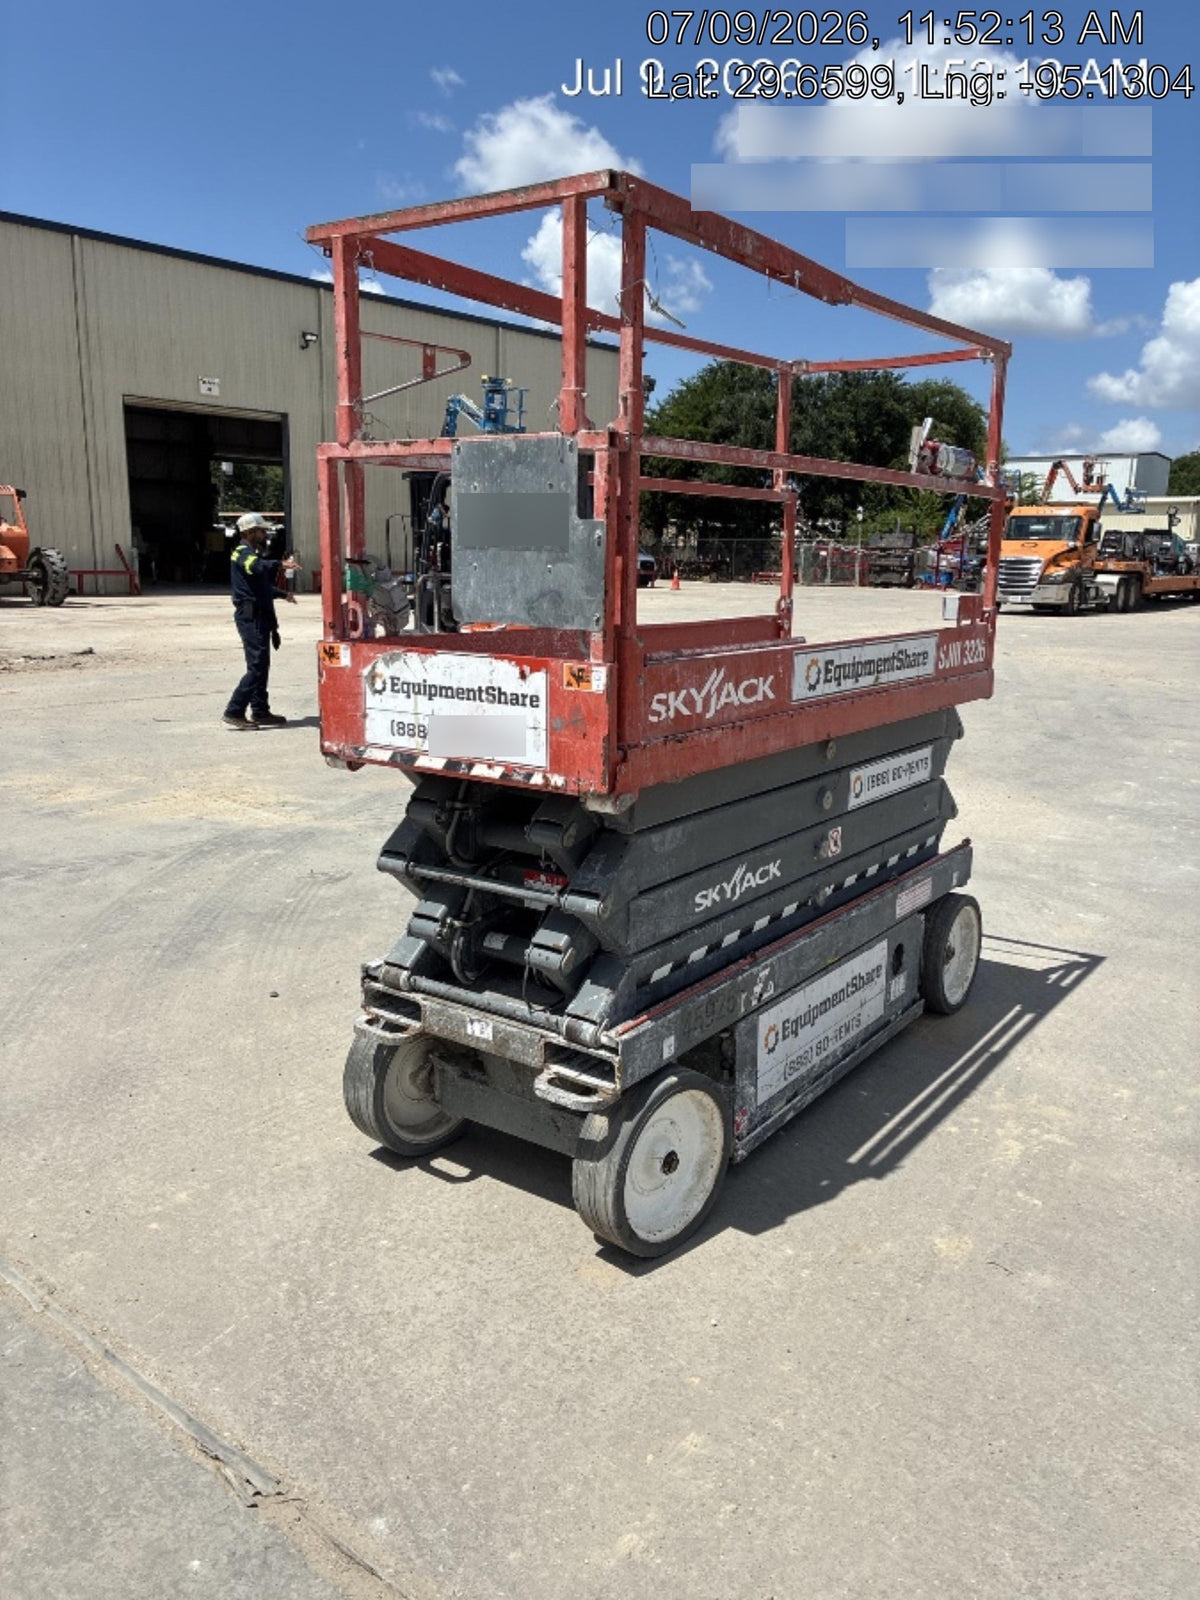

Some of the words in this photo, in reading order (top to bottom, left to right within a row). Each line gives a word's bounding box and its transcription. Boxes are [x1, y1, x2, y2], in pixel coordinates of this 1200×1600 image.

[389, 675, 540, 709] EquipmentShare
[648, 667, 776, 722] SKYJACK
[824, 648, 929, 687] EquipmentShare
[694, 858, 782, 913] SKYJACK
[781, 964, 883, 1041] EquipmentShare
